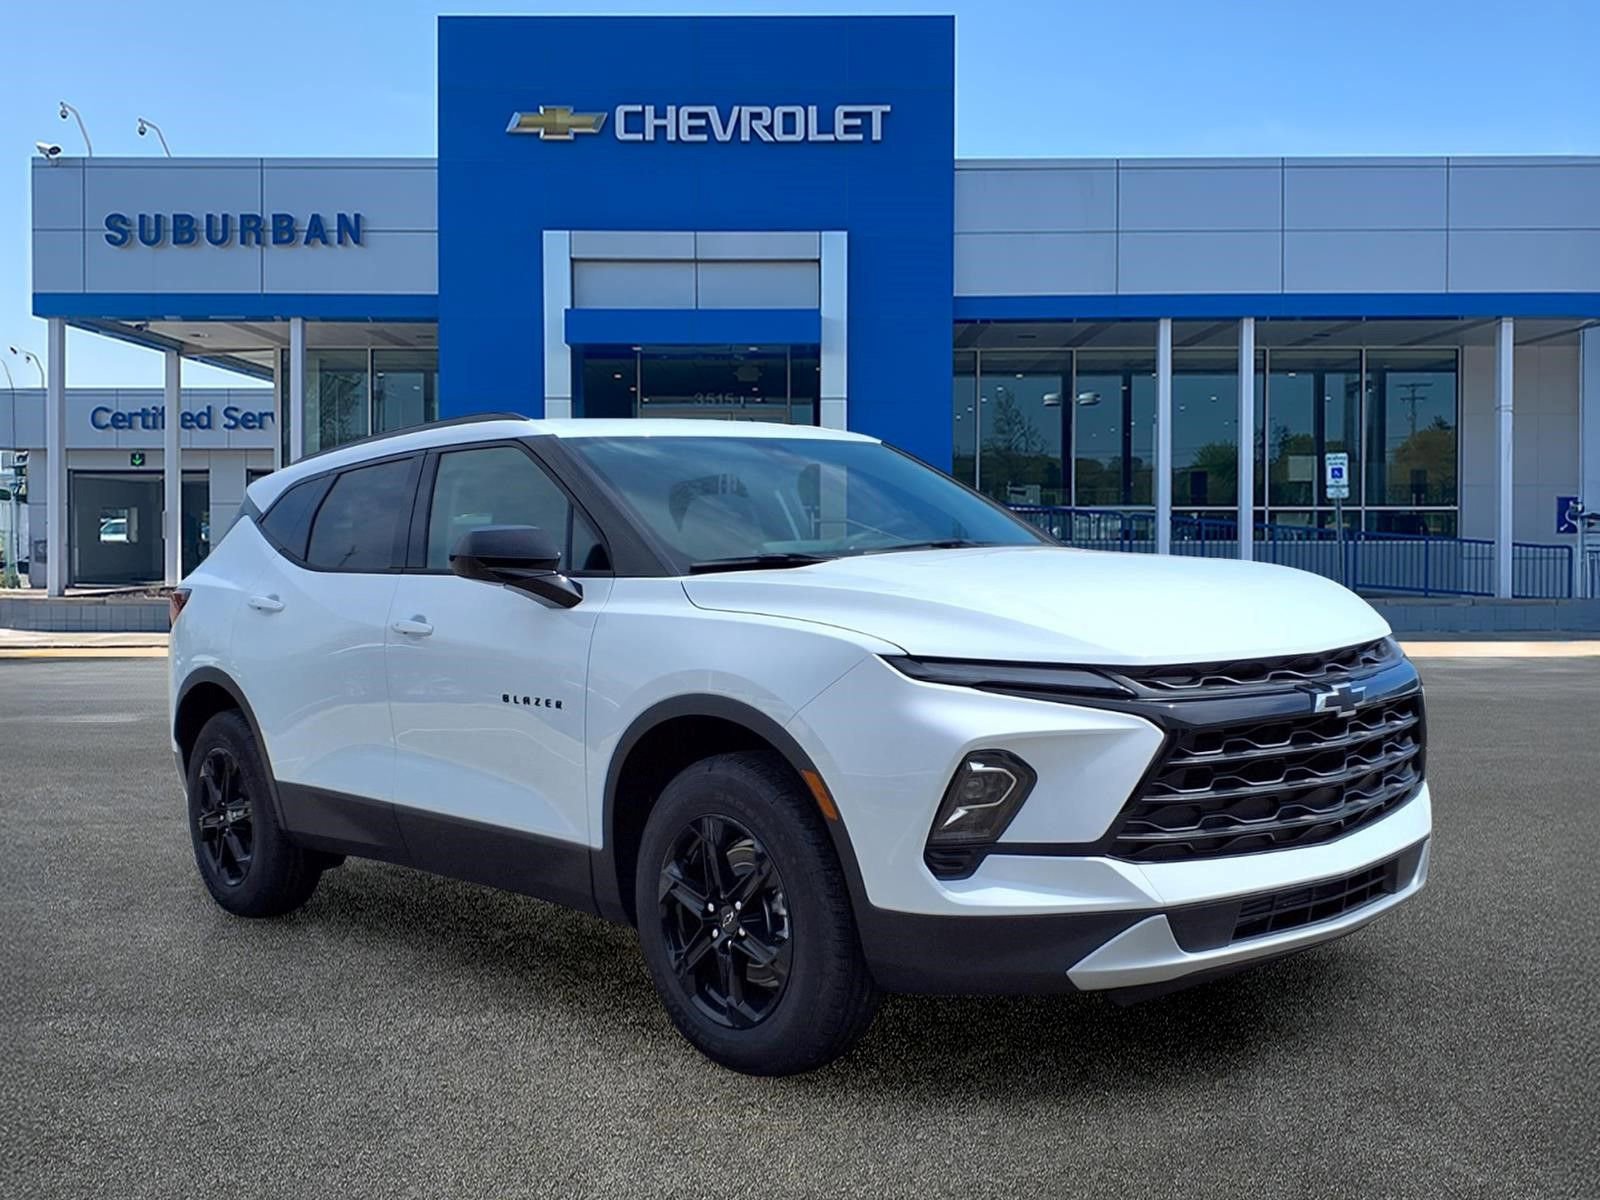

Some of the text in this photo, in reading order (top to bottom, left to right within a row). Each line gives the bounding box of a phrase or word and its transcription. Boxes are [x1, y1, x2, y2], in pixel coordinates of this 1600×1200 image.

[614, 104, 891, 142] CHEVROLET
[104, 213, 361, 246] SUBURBAN
[90, 406, 212, 430] Certifed
[502, 693, 562, 709] BLAZER
